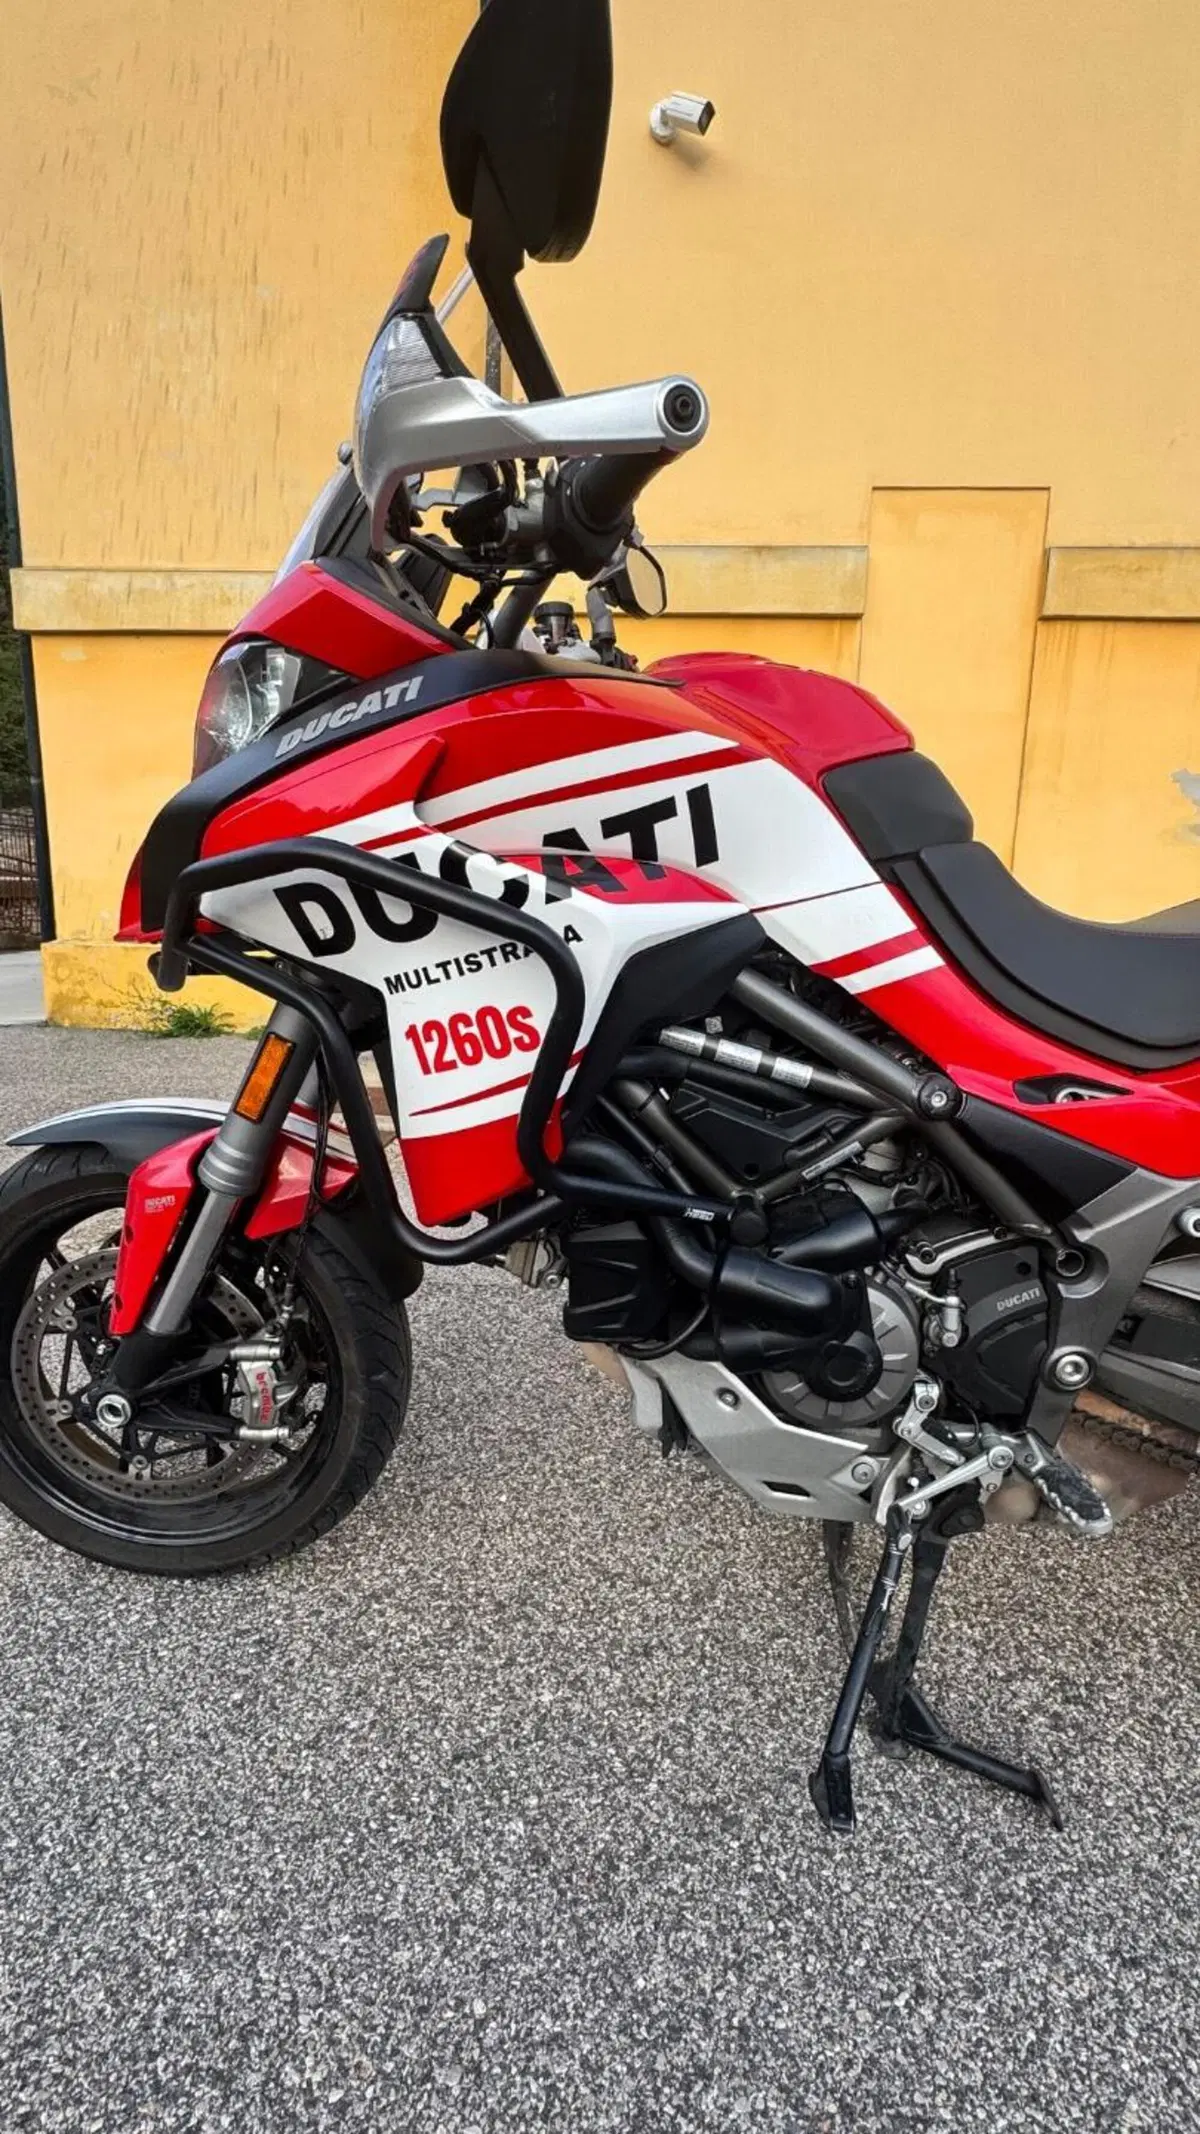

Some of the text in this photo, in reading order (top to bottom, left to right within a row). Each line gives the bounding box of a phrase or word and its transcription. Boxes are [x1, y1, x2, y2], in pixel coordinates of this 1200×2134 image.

[275, 675, 424, 758] DUCATI
[273, 782, 720, 958] DUCATI
[996, 1287, 1040, 1312] DUCATI
